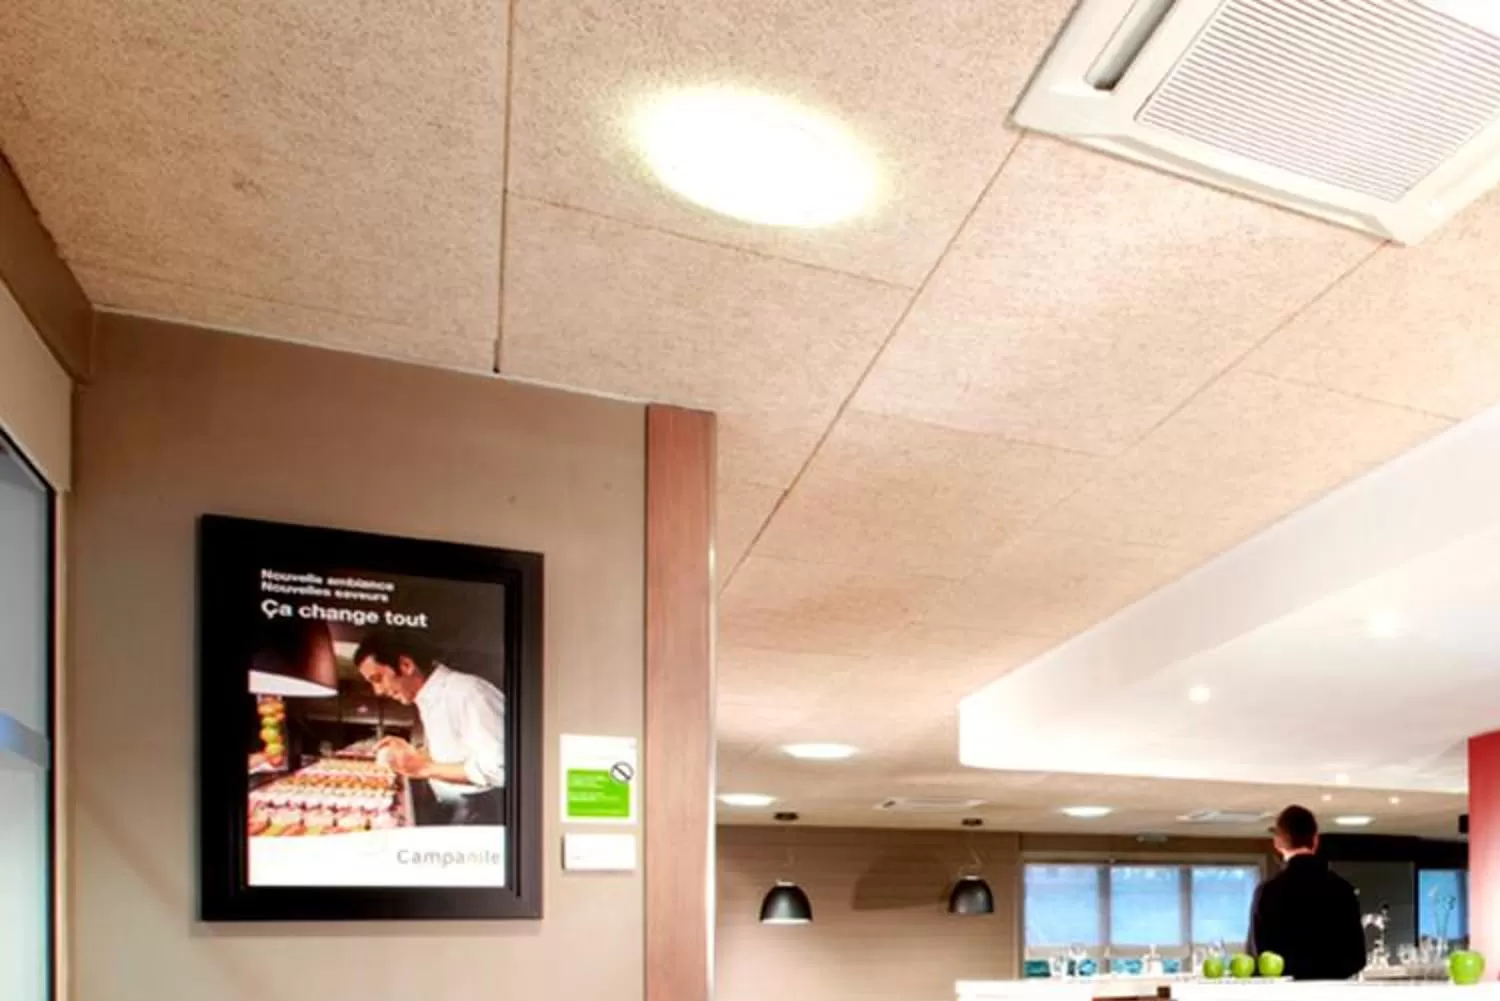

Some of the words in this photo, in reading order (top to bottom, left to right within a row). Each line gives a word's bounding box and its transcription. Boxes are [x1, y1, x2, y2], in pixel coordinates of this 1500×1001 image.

[260, 569, 323, 584] Nouvelle
[327, 576, 395, 591] ambiance
[260, 581, 332, 597] Nouvelles
[334, 588, 389, 602] saveurs
[261, 598, 293, 620] Ça
[298, 603, 379, 626] change
[384, 610, 428, 628] tout
[396, 849, 501, 869] Campanile
